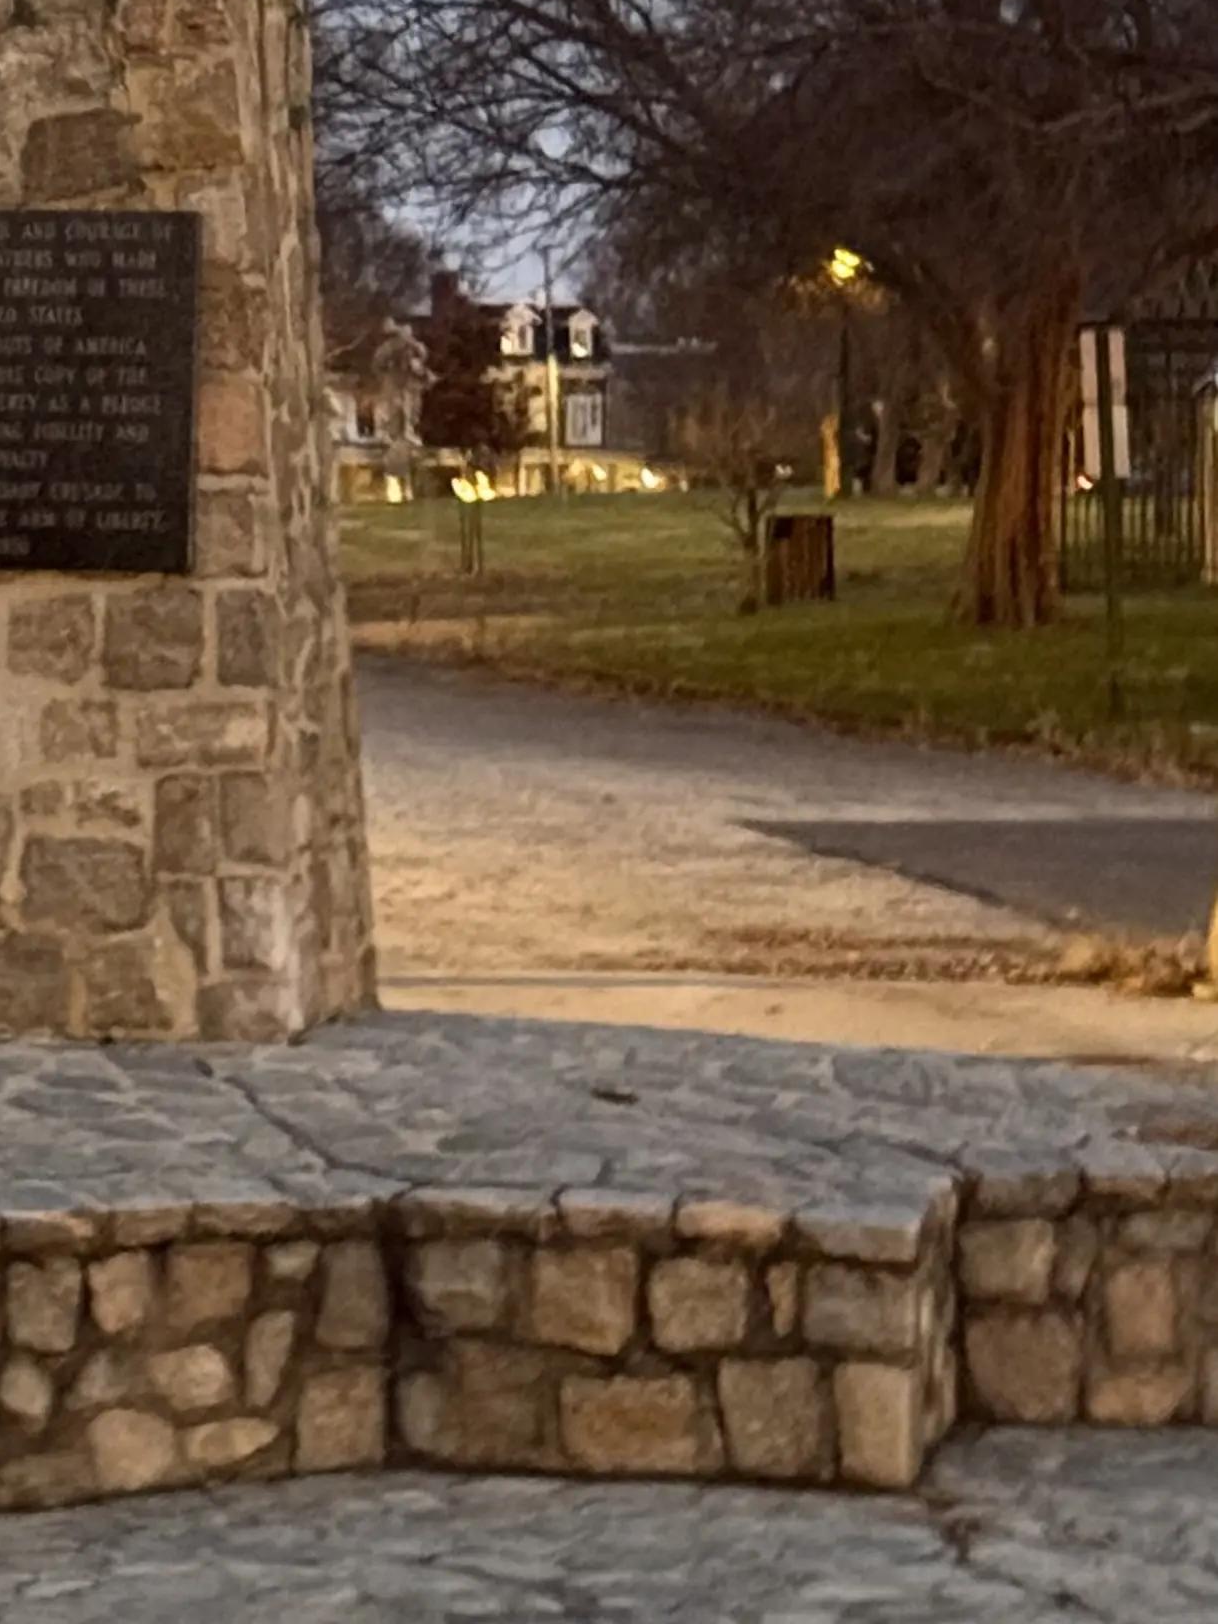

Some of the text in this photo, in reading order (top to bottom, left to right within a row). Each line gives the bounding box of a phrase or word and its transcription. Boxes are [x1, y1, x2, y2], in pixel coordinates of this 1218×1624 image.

[21, 221, 56, 240] AND
[79, 391, 91, 411] A
[116, 420, 149, 442] AND
